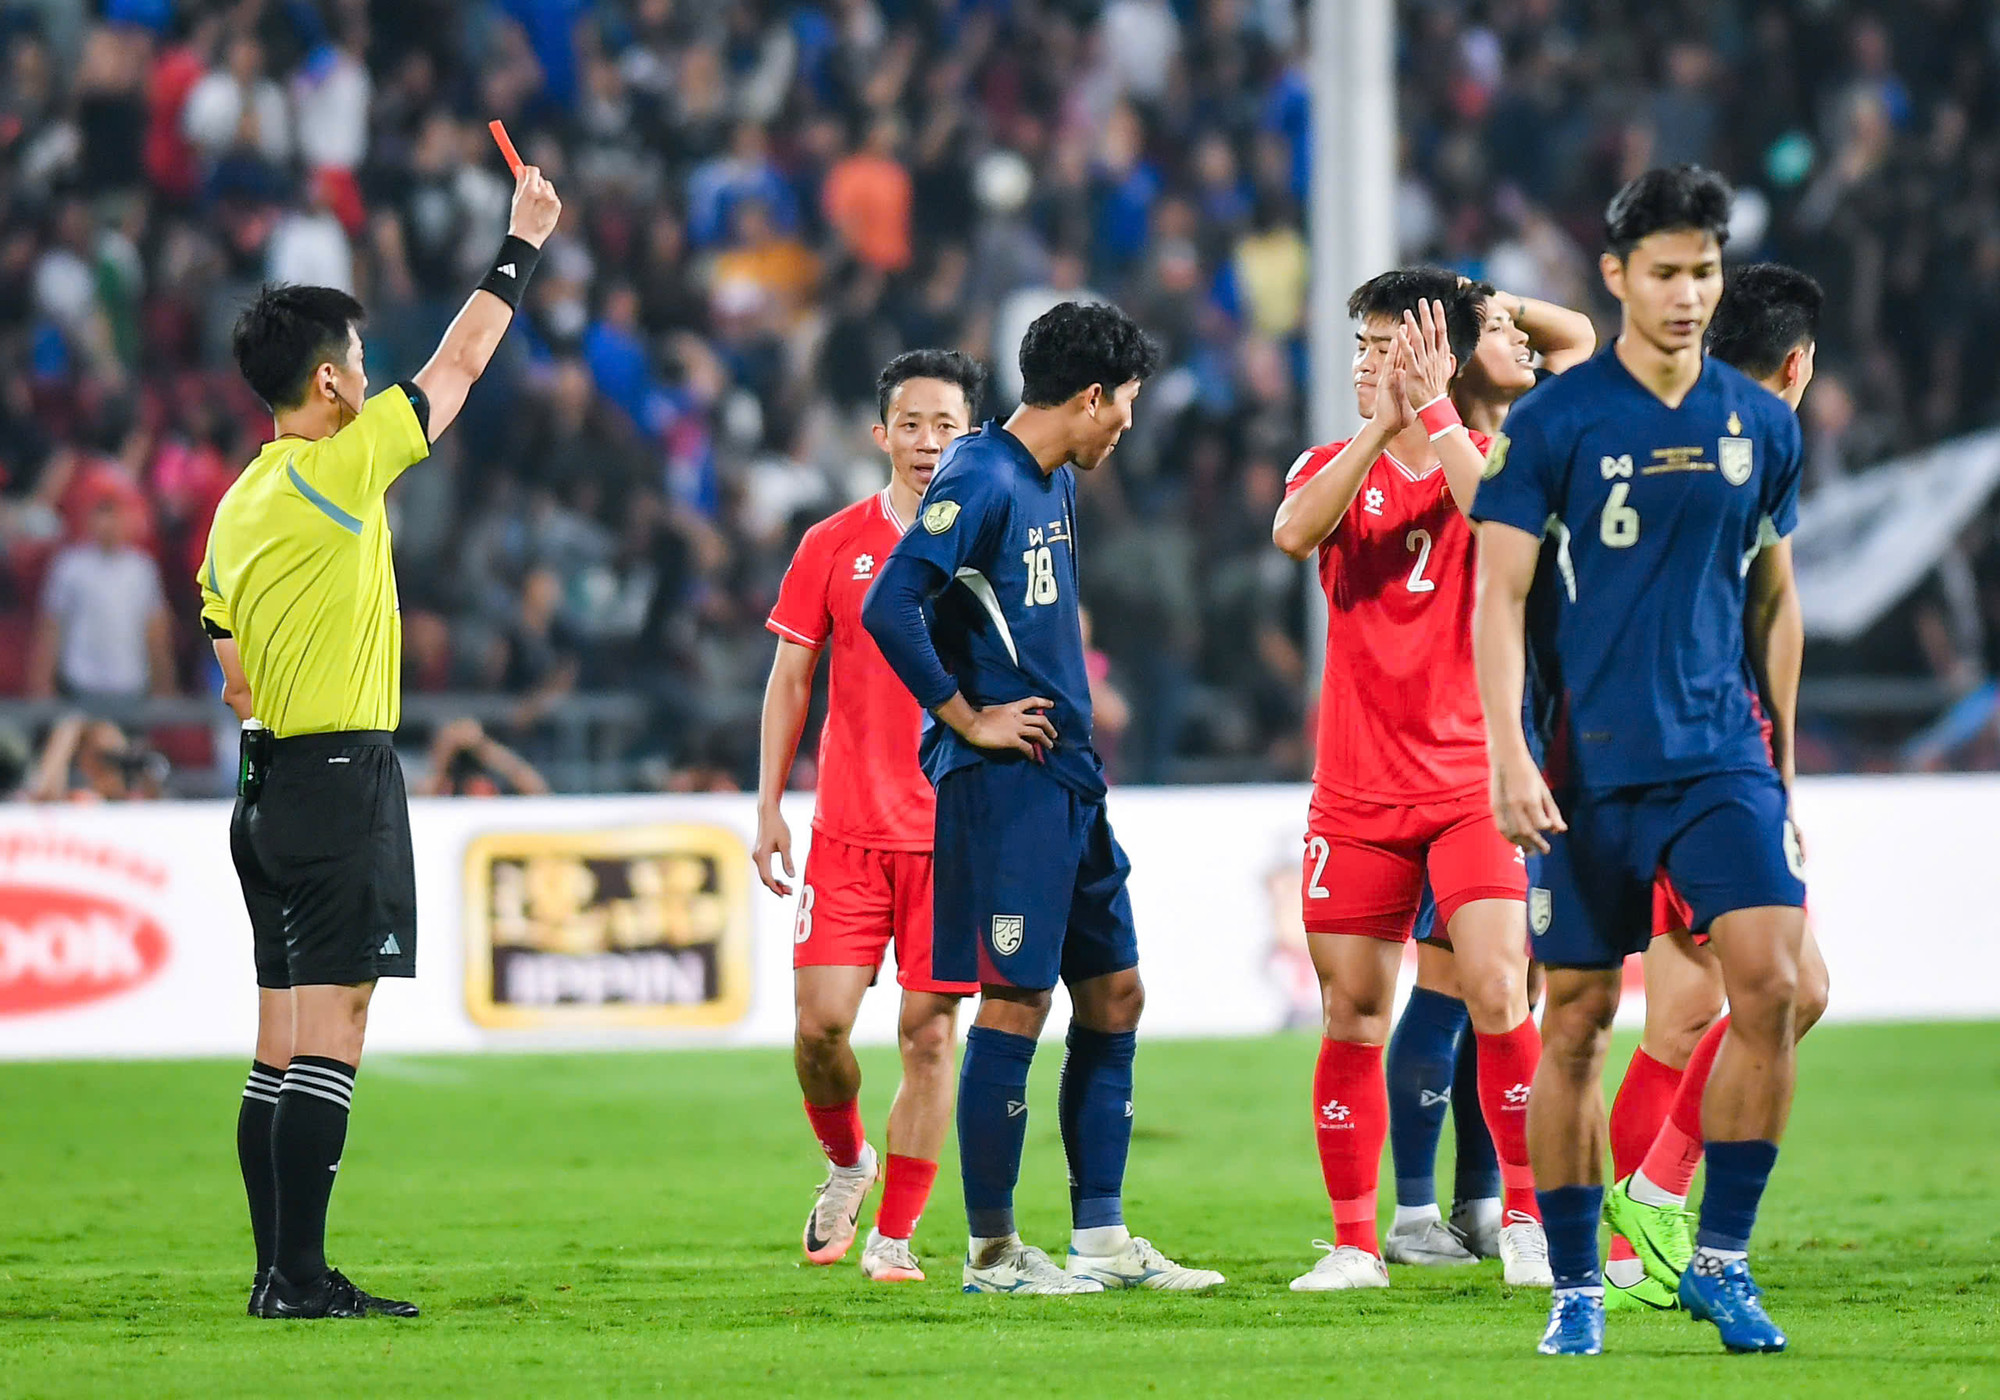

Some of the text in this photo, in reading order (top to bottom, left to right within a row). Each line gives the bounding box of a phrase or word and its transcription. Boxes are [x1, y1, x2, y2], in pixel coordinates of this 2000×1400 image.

[1600, 482, 1640, 549] 6
[1022, 547, 1058, 608] 18
[1406, 529, 1435, 592] 2
[1308, 836, 1330, 898] 2
[795, 884, 815, 944] 8
